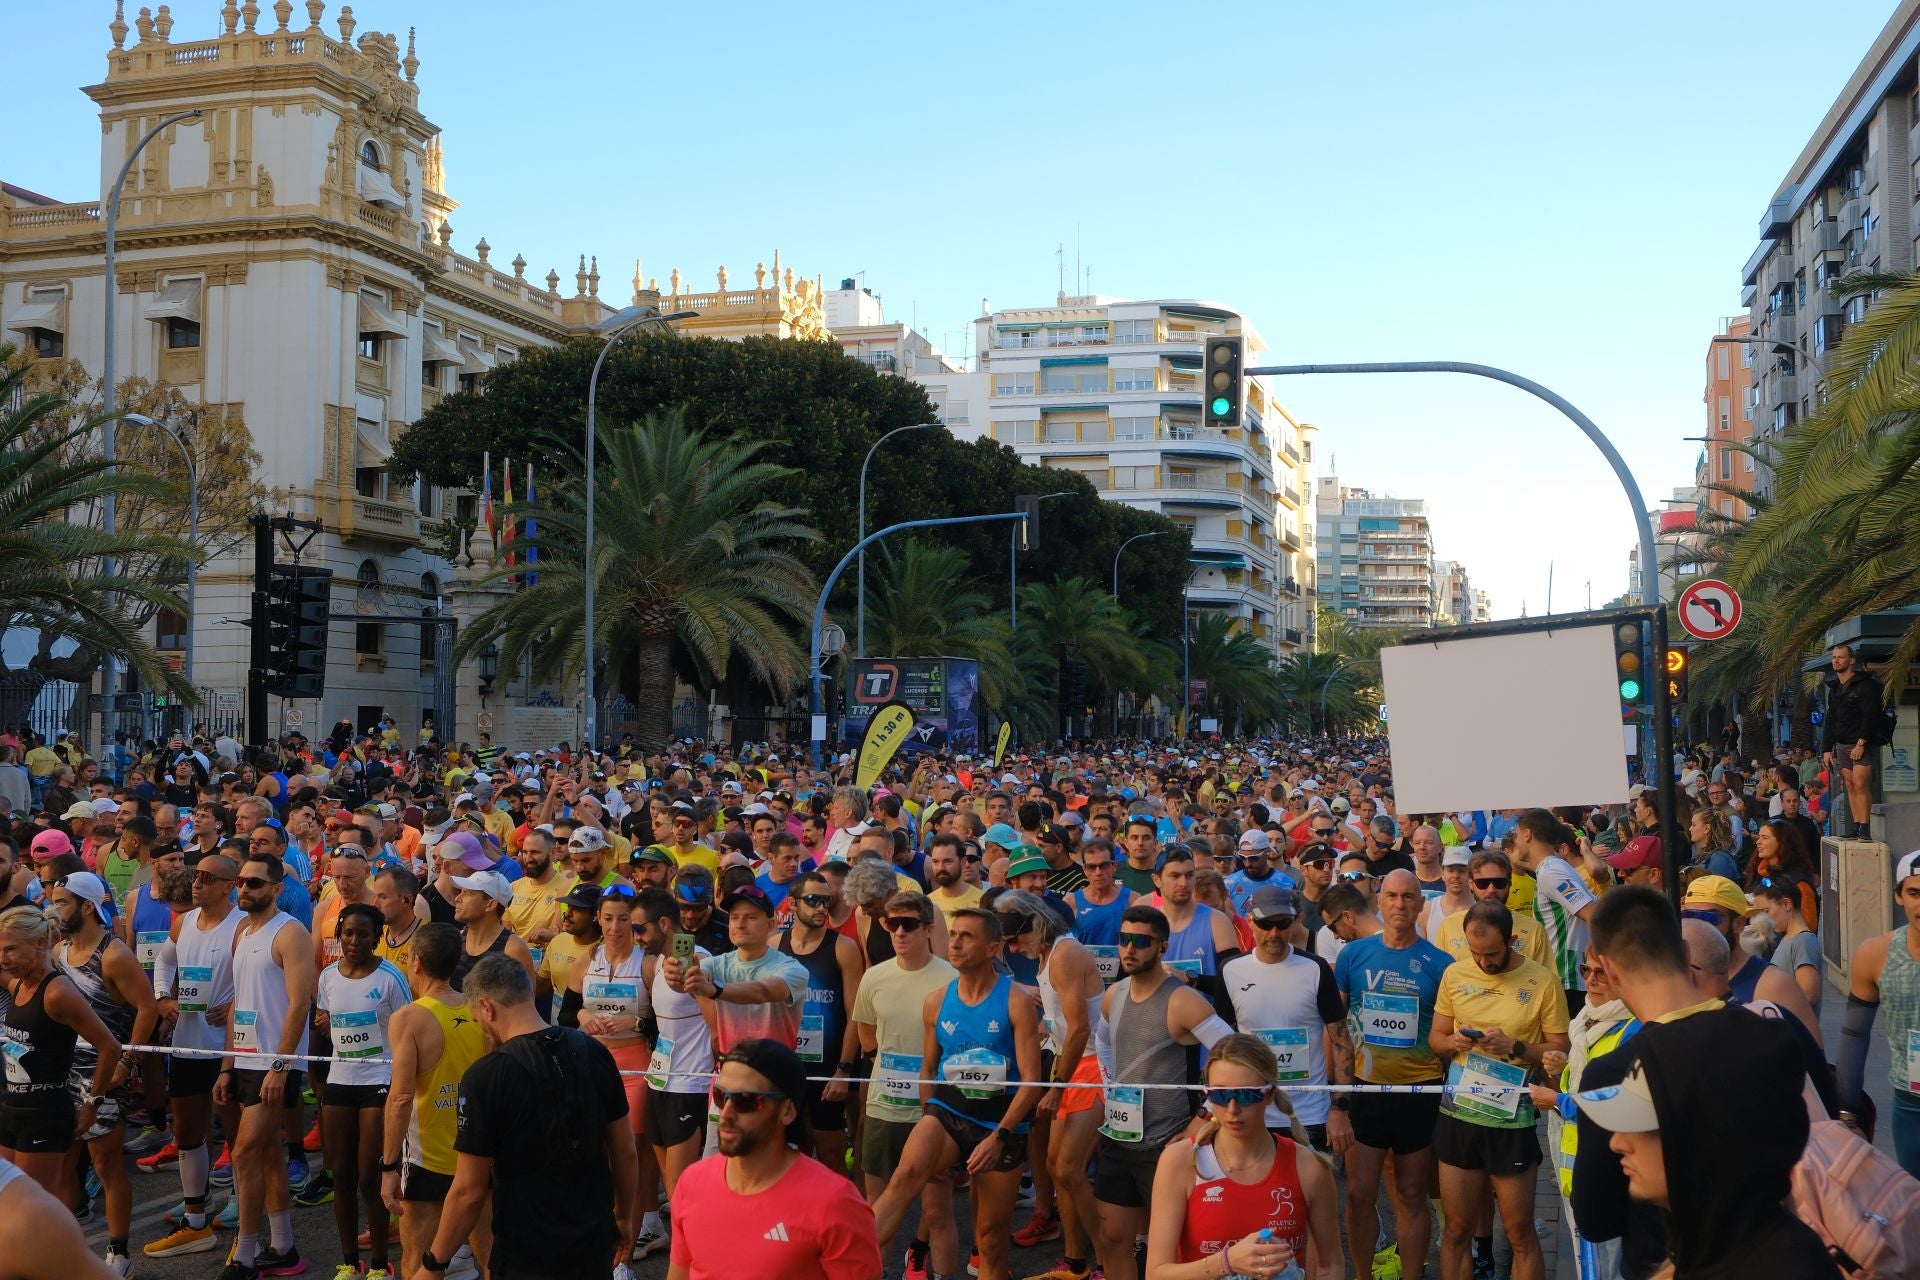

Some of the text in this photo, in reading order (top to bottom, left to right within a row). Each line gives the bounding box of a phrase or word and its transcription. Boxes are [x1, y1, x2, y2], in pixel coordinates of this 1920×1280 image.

[876, 733, 887, 742] h
[883, 720, 897, 735] 30
[894, 711, 905, 723] m
[147, 949, 153, 957] 6
[1384, 969, 1400, 977] Gran
[1365, 968, 1385, 992] V
[1384, 975, 1406, 983] Carrera
[178, 987, 198, 997] 268
[597, 1004, 626, 1012] 2006
[1372, 1018, 1407, 1031] 4000
[340, 1032, 370, 1045] 5008
[1277, 1053, 1293, 1063] 47
[959, 1071, 990, 1082] 1567
[1109, 1109, 1129, 1123] 2486
[1267, 1219, 1297, 1227] ATLETICA
